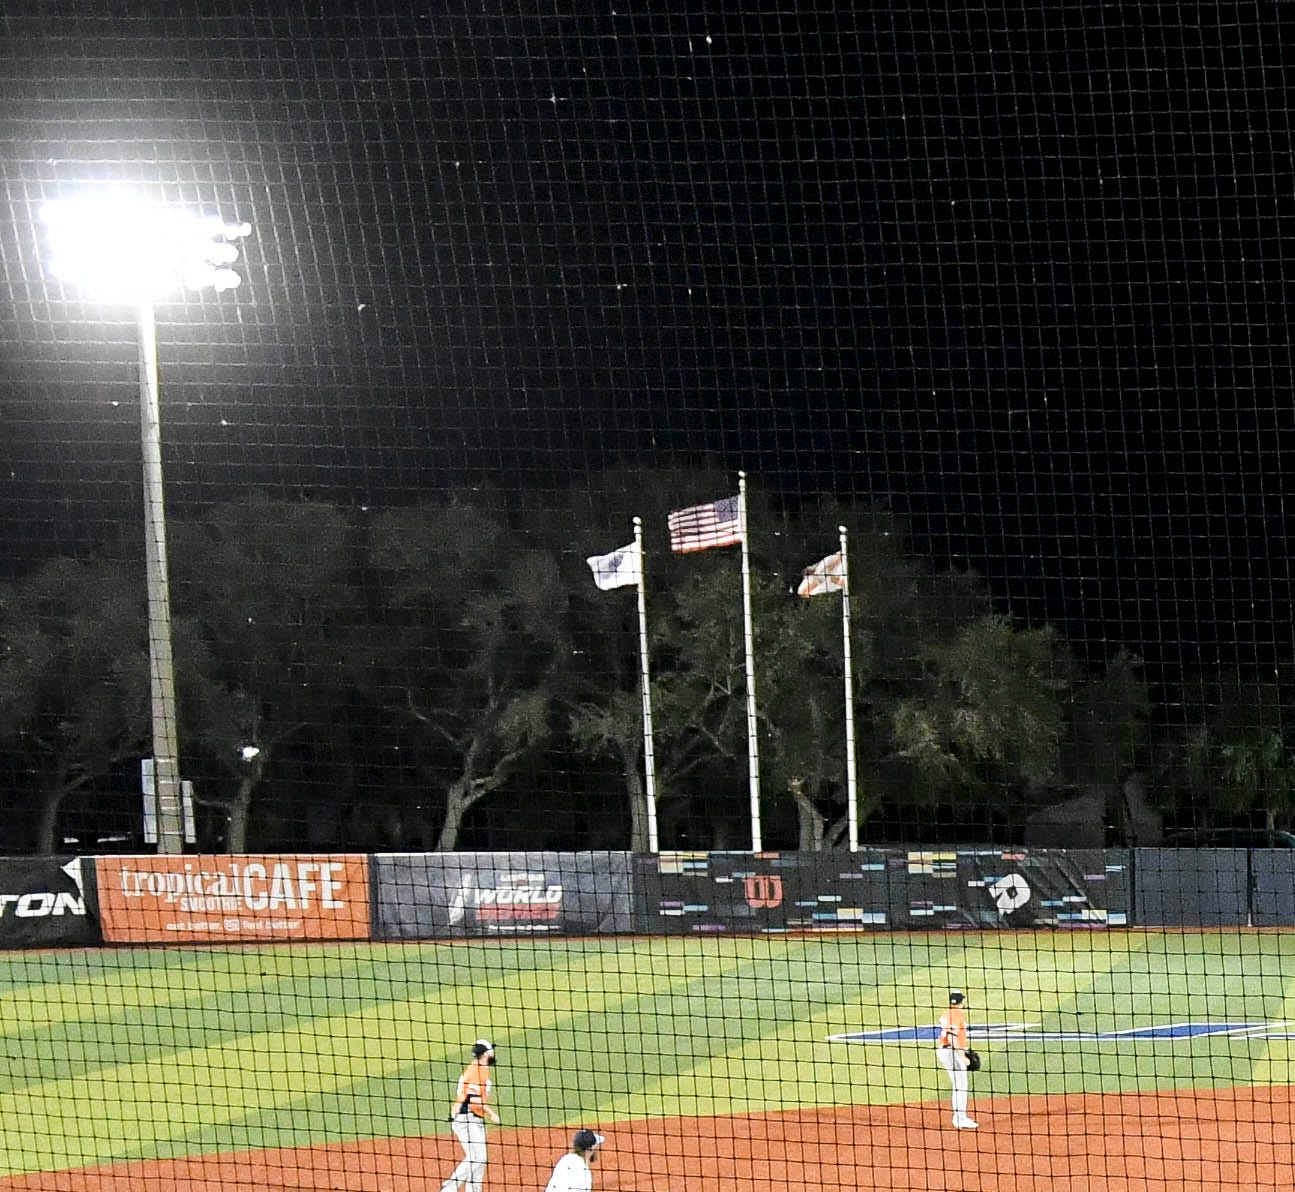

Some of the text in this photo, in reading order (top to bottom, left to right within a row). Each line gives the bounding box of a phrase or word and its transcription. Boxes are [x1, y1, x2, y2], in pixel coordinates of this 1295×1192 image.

[119, 863, 242, 903] tropical
[243, 862, 345, 911] CAFE
[474, 885, 563, 904] WORLD
